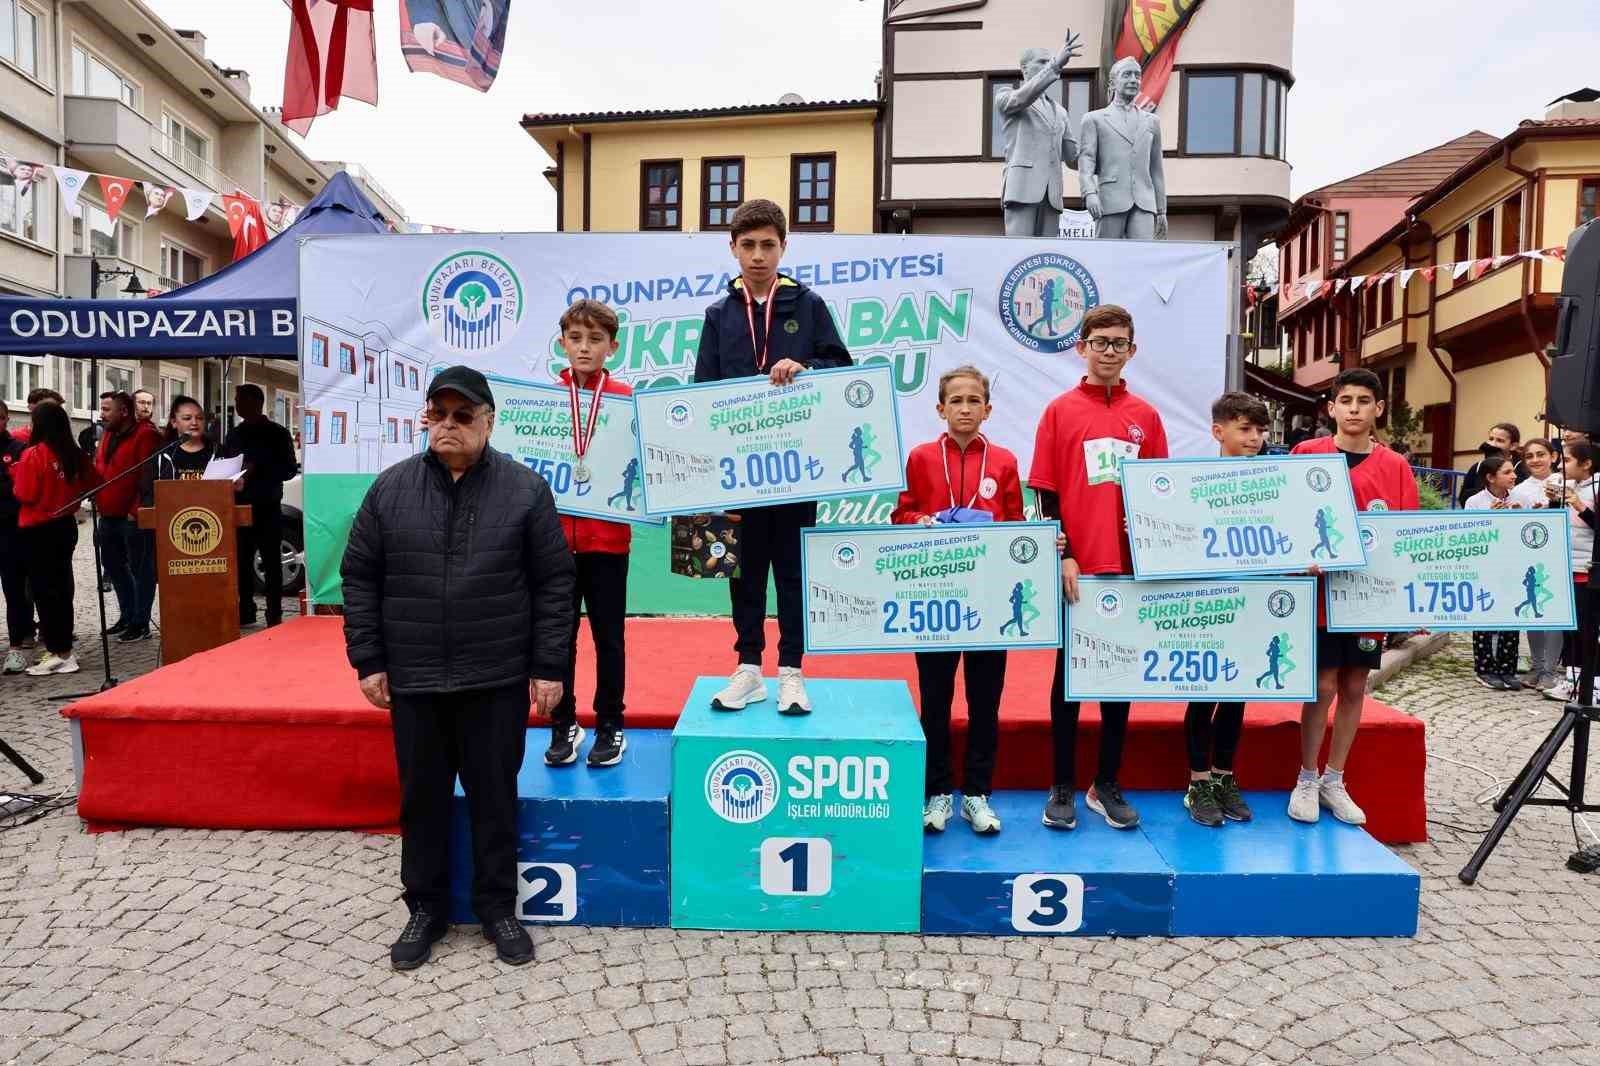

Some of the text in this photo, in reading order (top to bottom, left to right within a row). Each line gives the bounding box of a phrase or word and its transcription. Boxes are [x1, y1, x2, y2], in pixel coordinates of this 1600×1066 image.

[567, 272, 732, 306] ODUNPAZA
[10, 308, 296, 339] ODUNPAZARI B
[500, 407, 553, 426] ŞÜKRÜ
[709, 401, 764, 431] ŞÜKRÜ
[768, 391, 822, 413] SABAN
[728, 409, 812, 436] YOL KOŞUSU
[514, 424, 538, 436] YOL
[1189, 479, 1237, 504] ŞÜKRÜ
[1241, 474, 1288, 491] SABAN
[1207, 488, 1280, 509] YOL KOŞUSU
[878, 534, 980, 553] ODUNPAZARI BELEDİYESİ
[1393, 532, 1444, 557] ŞÜKRÜ
[1448, 529, 1499, 547] SABAN
[1396, 524, 1448, 537] ODUNPAZARI
[875, 549, 929, 575] ŞÜKRÜ
[932, 544, 987, 562] SABAN
[1409, 544, 1489, 563] YOL KOŞUSU
[892, 560, 976, 581] YOL KOŞUSU
[1141, 590, 1194, 602] ODUNPAZARI
[1137, 600, 1190, 624] ŞÜKRÜ
[1193, 596, 1246, 614] SABAN
[1153, 612, 1235, 631] YOL KOŞUSU
[787, 755, 890, 800] SPOR
[787, 802, 890, 820] İŞLERİ MÜDÜRLÜĞÜ
[778, 842, 809, 892] 1
[520, 865, 564, 916] 2
[1027, 878, 1069, 927] 3
